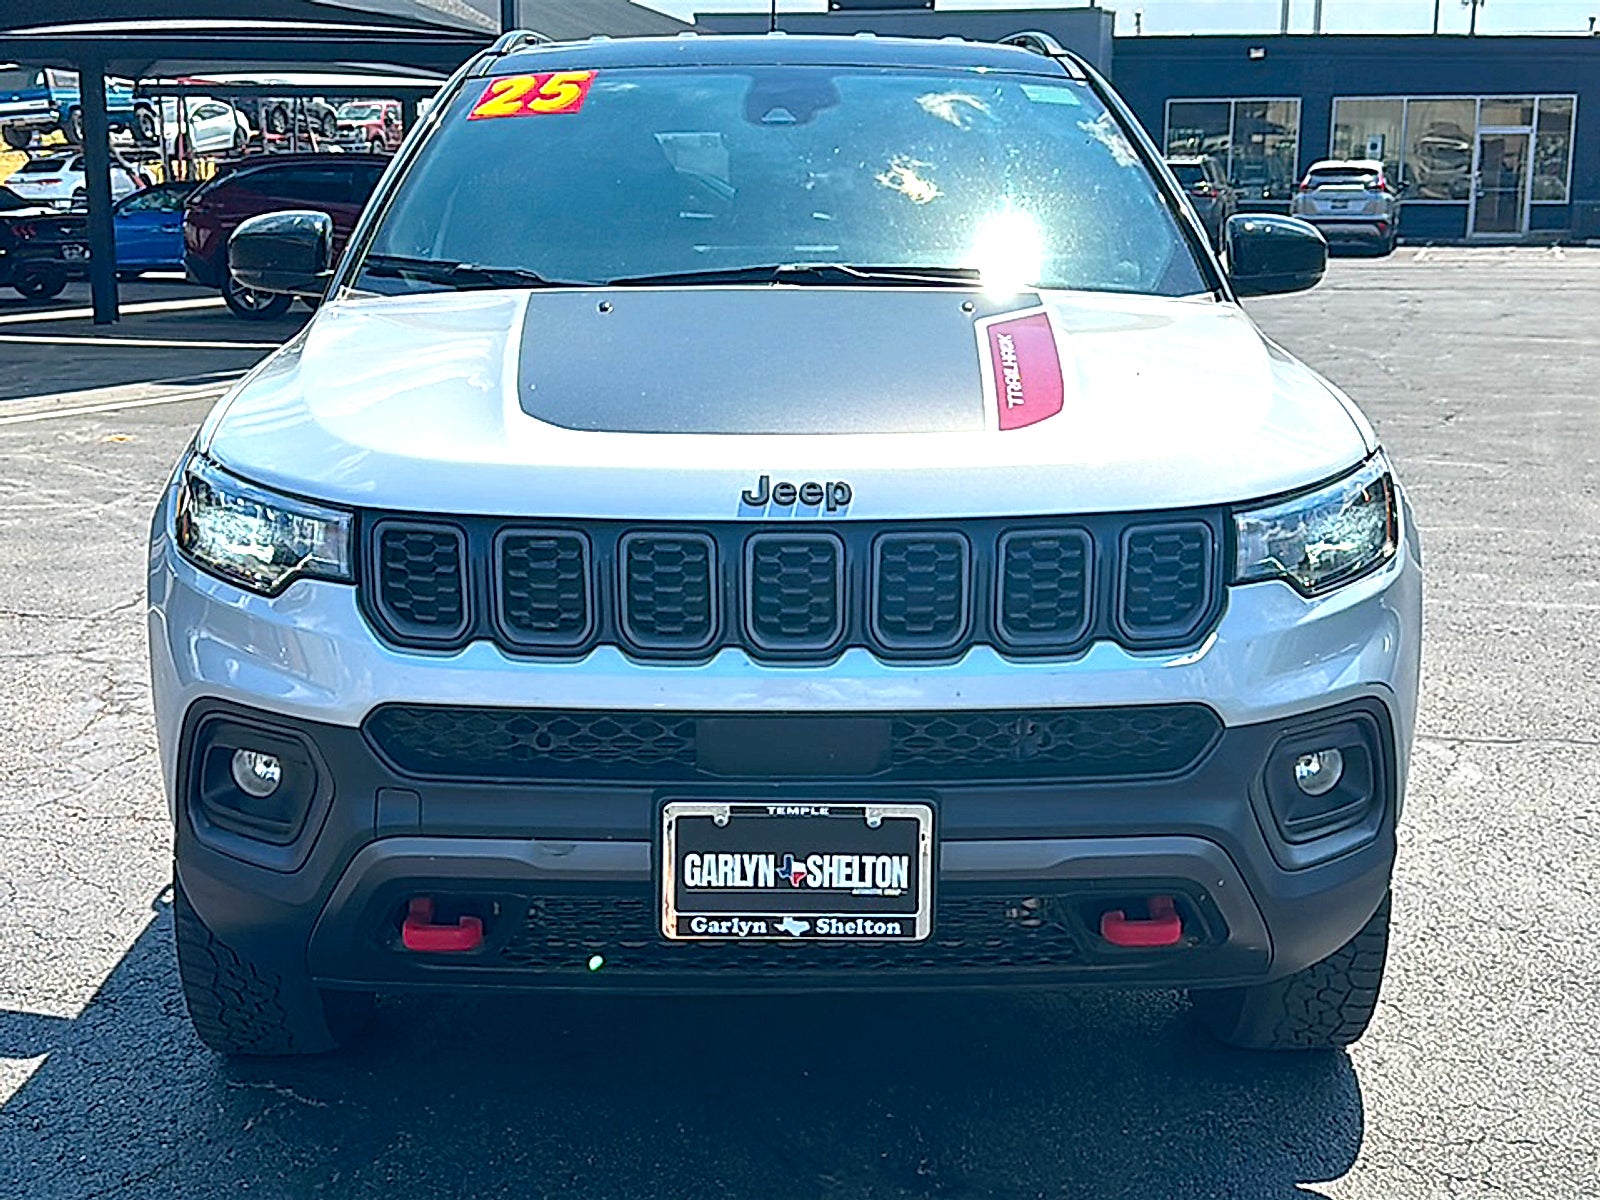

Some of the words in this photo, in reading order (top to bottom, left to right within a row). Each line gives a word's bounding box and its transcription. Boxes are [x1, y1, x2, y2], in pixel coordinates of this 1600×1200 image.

[473, 70, 591, 116] 25
[741, 475, 852, 512] Jeep
[767, 806, 829, 816] TEMPLE
[684, 854, 775, 887] GARLYN
[806, 855, 909, 888] SHELTON
[690, 917, 767, 937] Garlyn
[816, 918, 901, 935] Shelton
